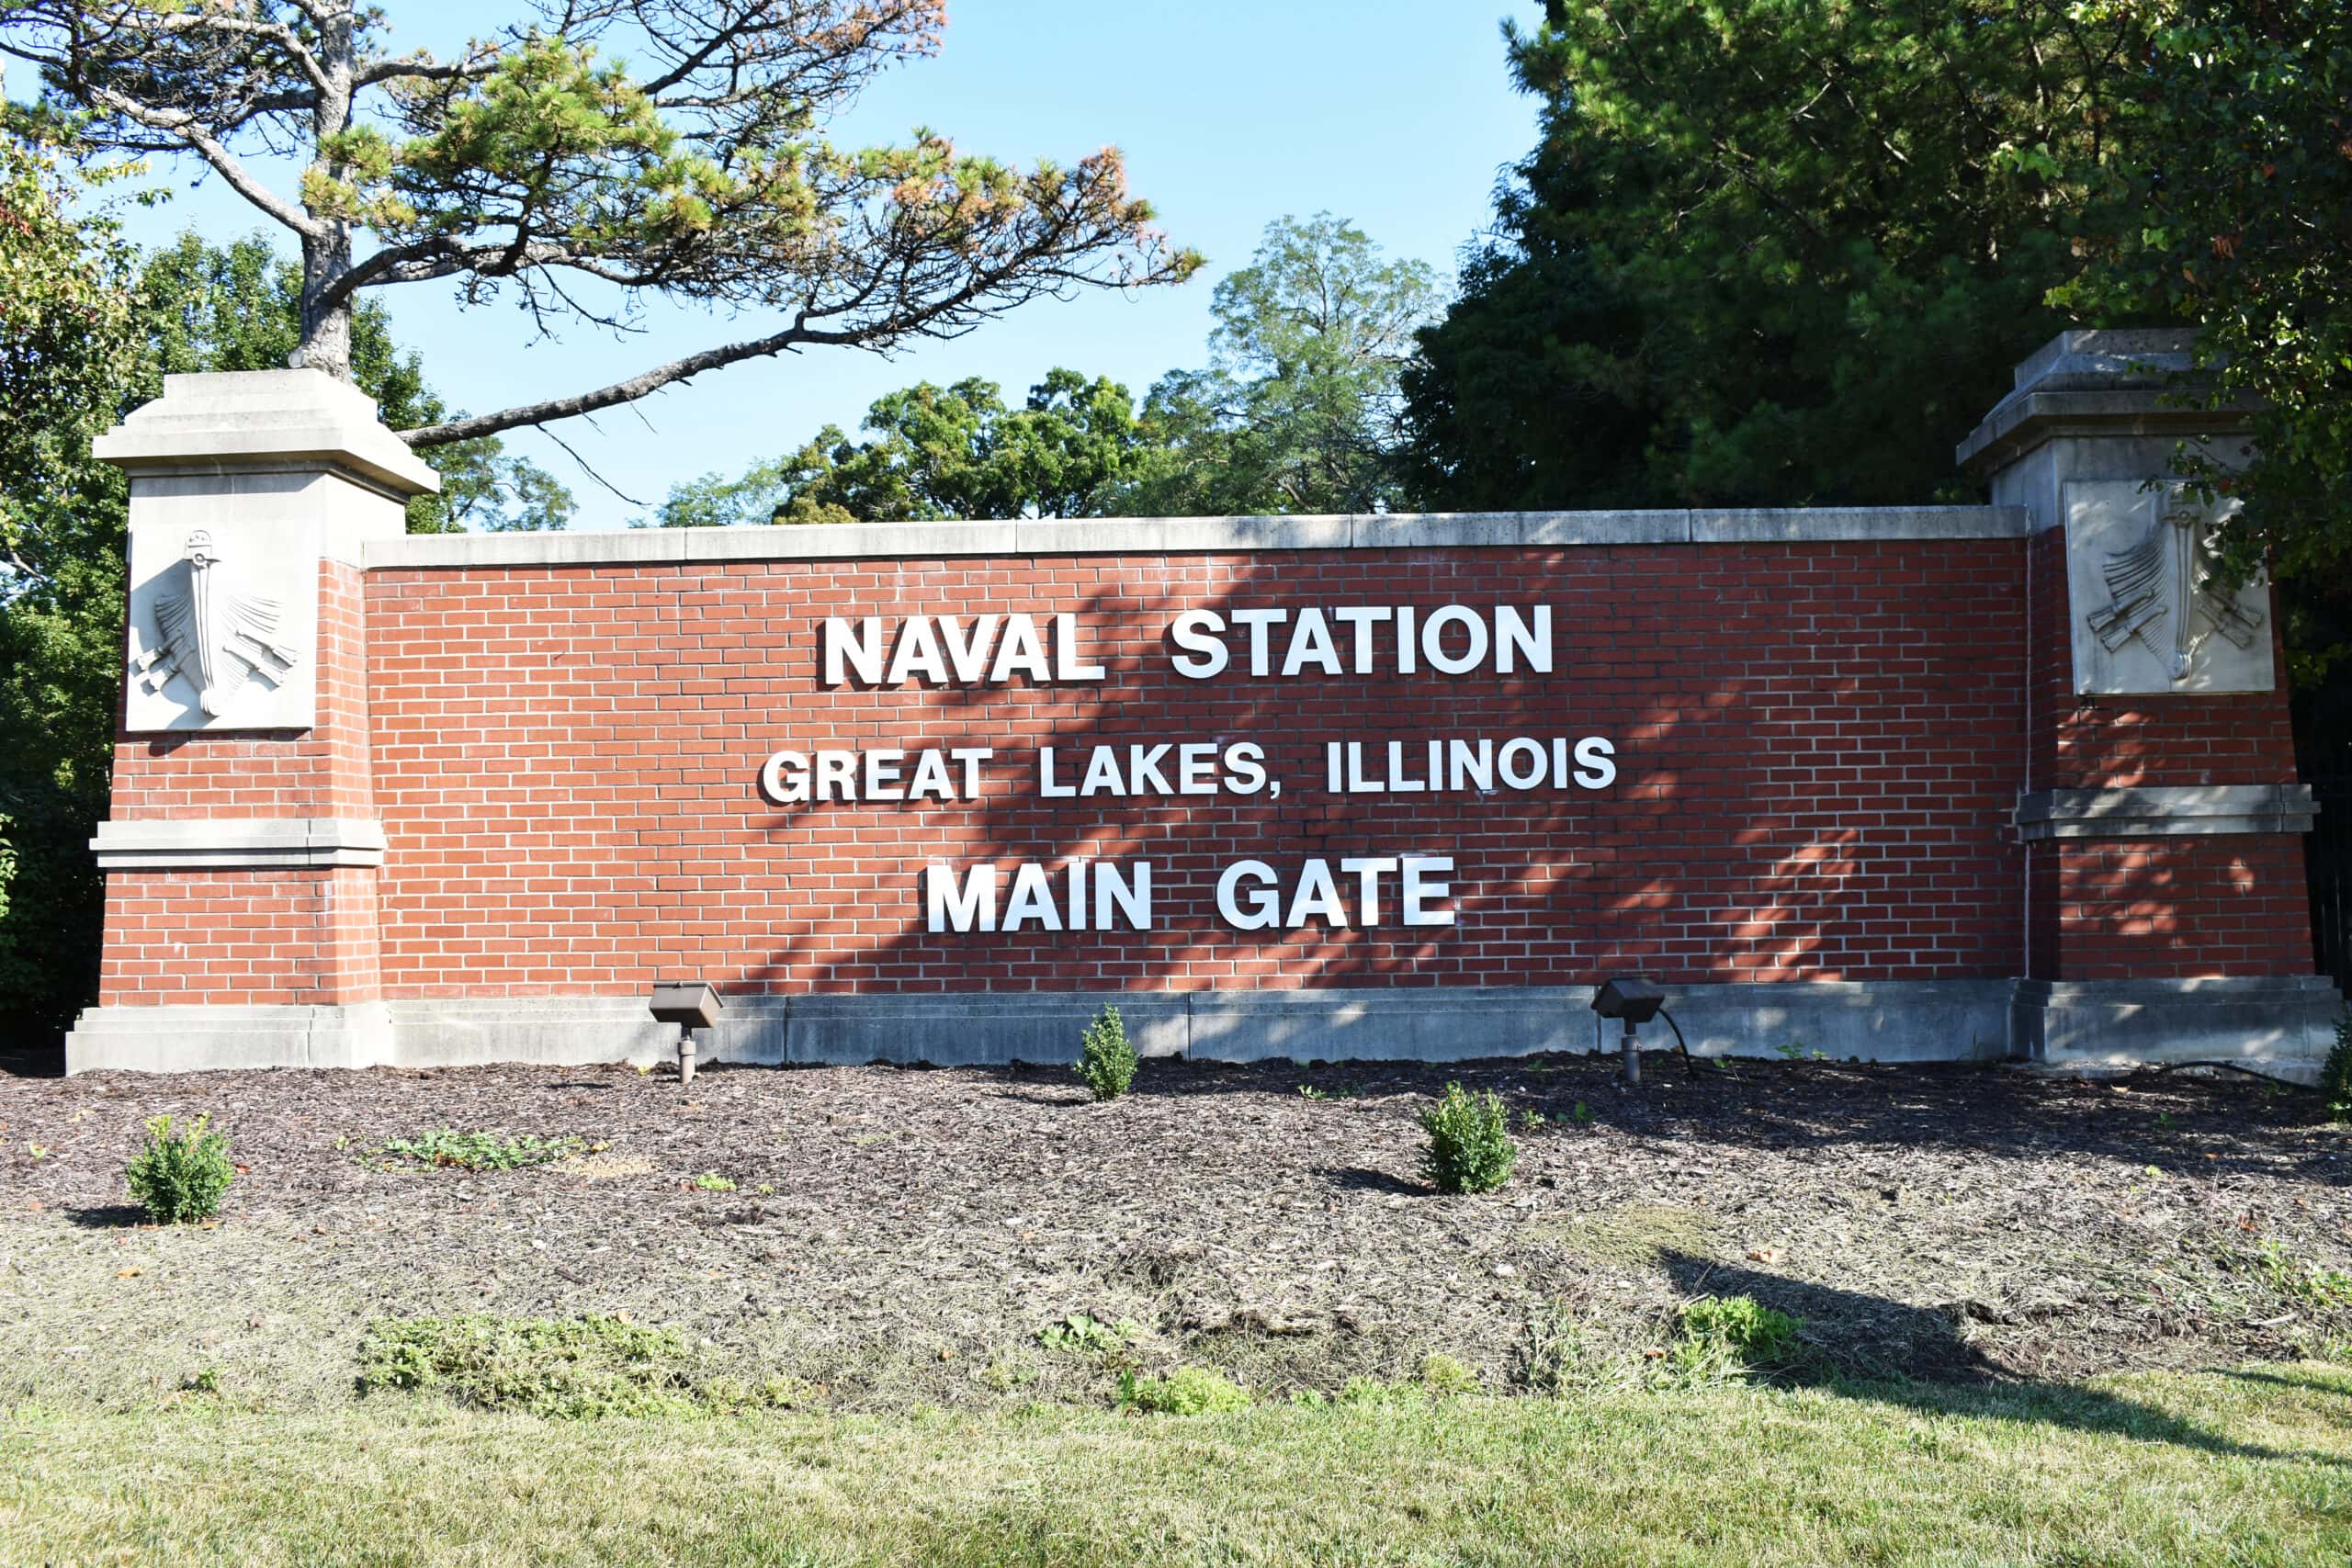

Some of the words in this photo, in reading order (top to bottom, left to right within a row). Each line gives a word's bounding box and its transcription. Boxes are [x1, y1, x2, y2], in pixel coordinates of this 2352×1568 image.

[823, 613, 1106, 685] NAVAL
[1171, 604, 1554, 680] STATION
[763, 747, 993, 802] GREAT
[1040, 741, 1283, 800] LAKES,
[1328, 737, 1617, 794] ILLINOIS
[925, 859, 1152, 933] MAIN
[1216, 855, 1455, 930] GATE
